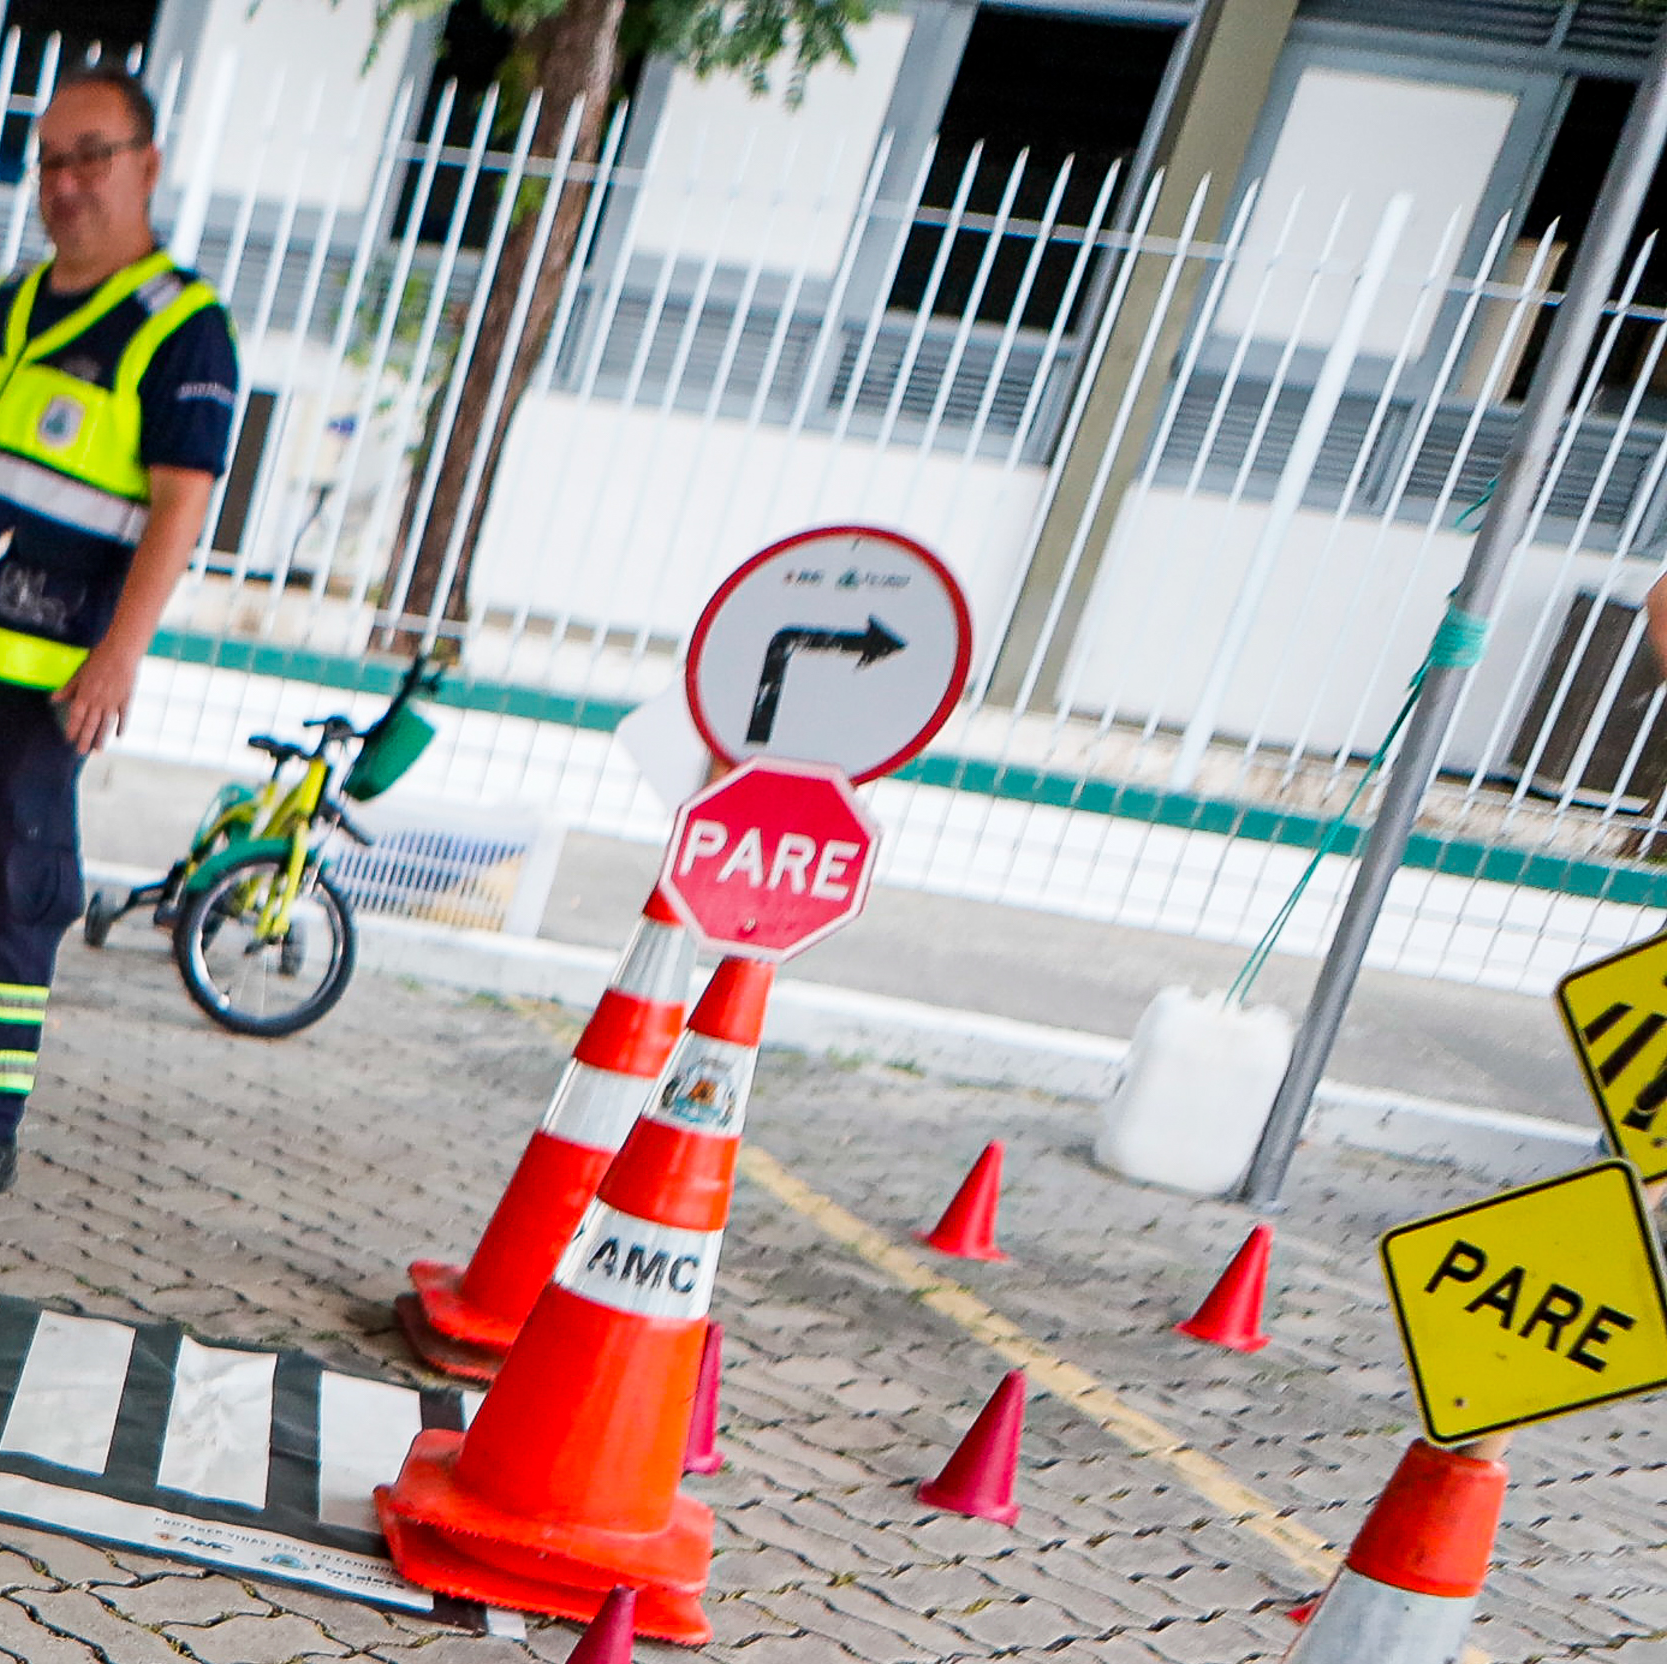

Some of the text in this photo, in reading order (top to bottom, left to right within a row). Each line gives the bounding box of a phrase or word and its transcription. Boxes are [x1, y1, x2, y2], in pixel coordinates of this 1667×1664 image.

[679, 818, 862, 901] PARE
[587, 1236, 700, 1293] AMC
[1424, 1239, 1637, 1373] PARE
